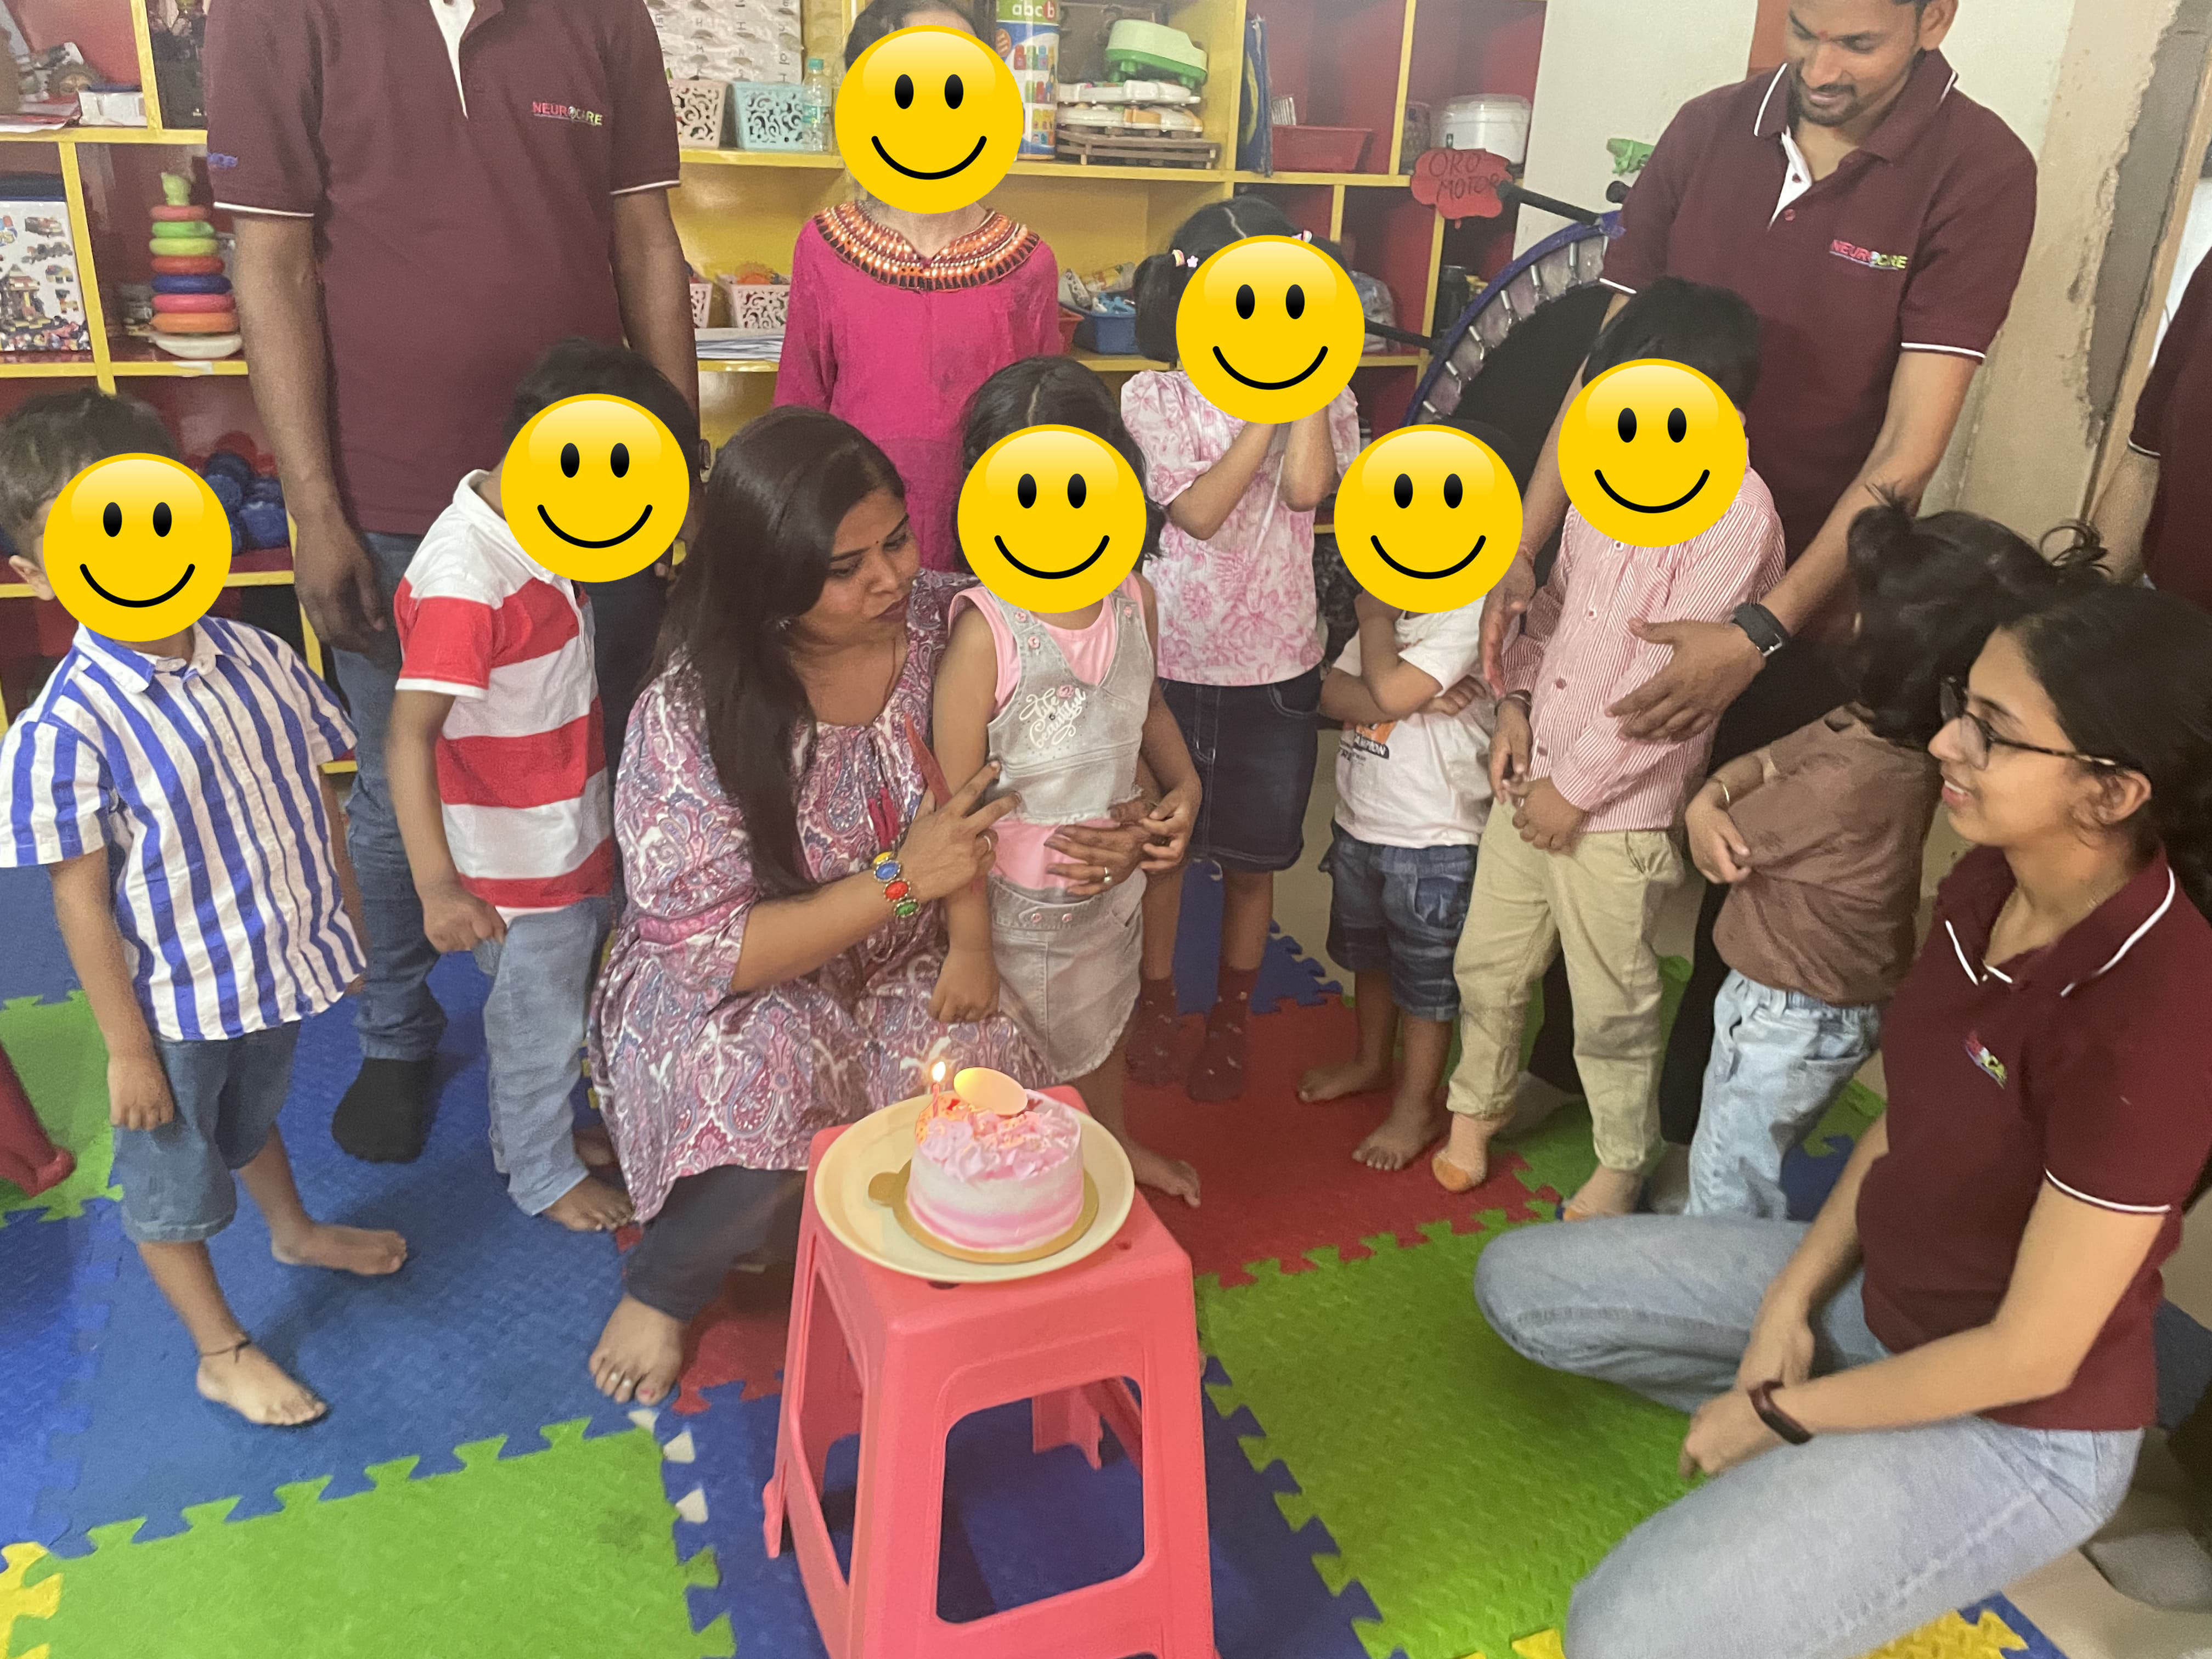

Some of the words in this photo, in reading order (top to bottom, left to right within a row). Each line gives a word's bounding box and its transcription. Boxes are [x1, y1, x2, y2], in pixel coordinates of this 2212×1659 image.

[532, 101, 603, 126] NEUROCRE
[1436, 172, 1499, 203] MOTOR
[1830, 239, 1909, 269] NEUROCRE
